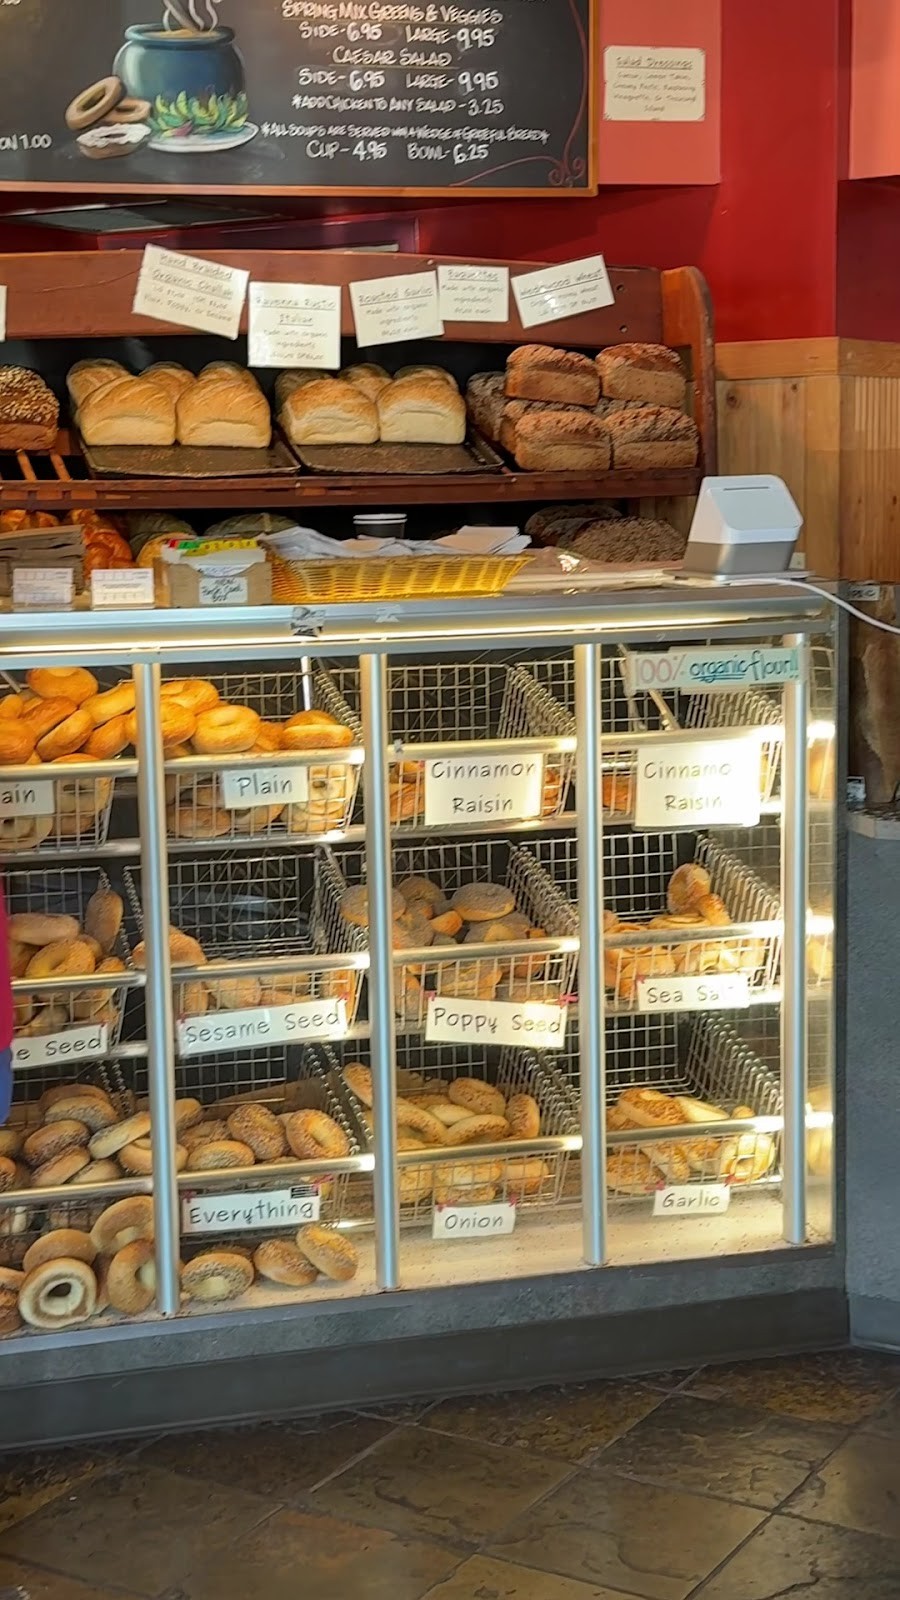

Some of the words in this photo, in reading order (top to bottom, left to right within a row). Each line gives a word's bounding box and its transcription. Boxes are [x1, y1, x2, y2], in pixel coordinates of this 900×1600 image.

[281, 0, 338, 19] SPRING
[339, 2, 368, 19] MIX
[440, 5, 503, 24] VEGGIES
[332, 45, 397, 65] CAESAR
[399, 48, 452, 66] SALAD
[416, 97, 456, 113] SALAD
[19, 133, 52, 150] 1.00
[635, 653, 687, 687] 100%
[689, 655, 749, 684] organic
[430, 759, 538, 779] Cinnamon
[644, 761, 733, 779] Cinnamo
[235, 775, 292, 798] Plain
[452, 795, 514, 815] Raisin
[664, 794, 722, 812] Raisin
[646, 986, 683, 1004] Sea
[696, 984, 734, 1002] Sa
[185, 1020, 271, 1045] Sesame
[284, 1001, 340, 1031] Seed
[433, 1007, 499, 1034] Poppy
[511, 1008, 562, 1034] Seed
[45, 1030, 103, 1055] Seed
[662, 1190, 721, 1210] Garlic
[189, 1198, 315, 1226] Everything
[444, 1212, 504, 1231] Onion
